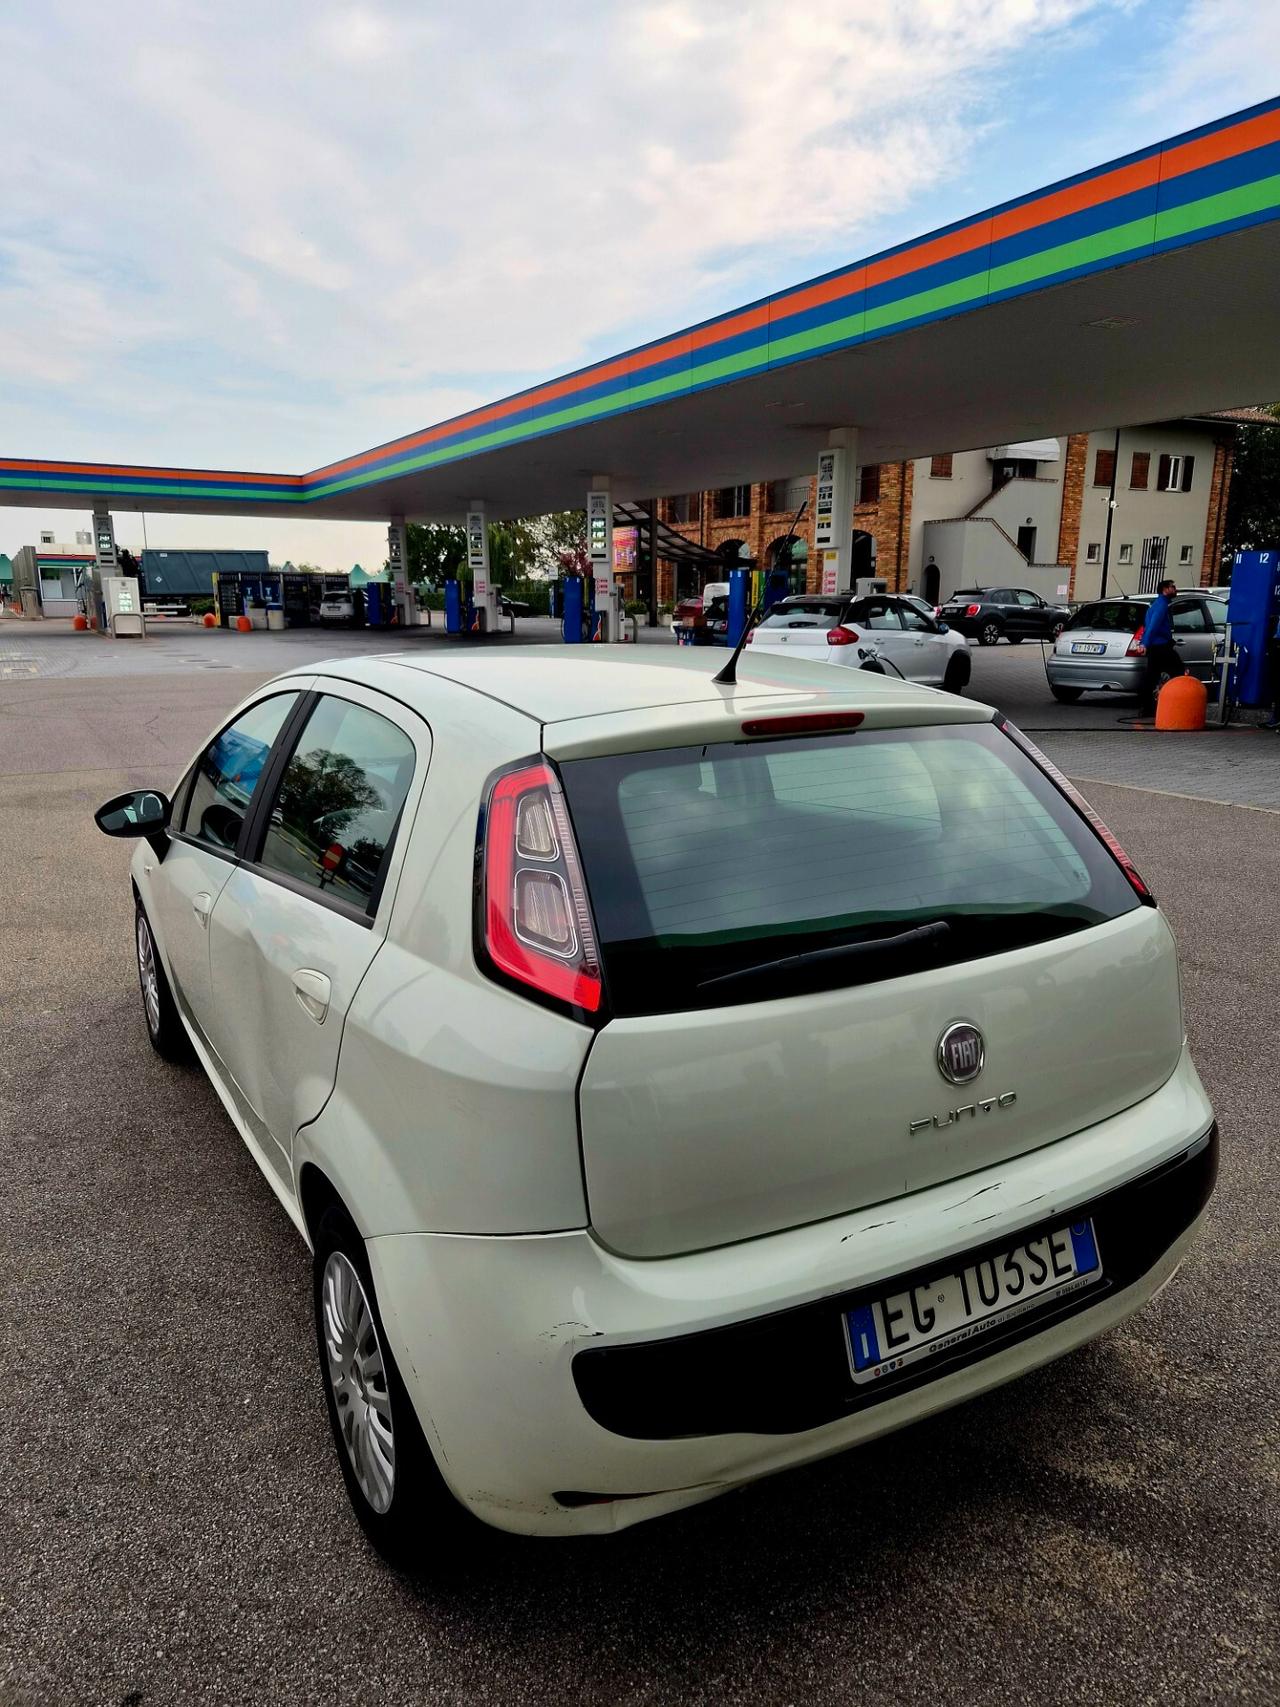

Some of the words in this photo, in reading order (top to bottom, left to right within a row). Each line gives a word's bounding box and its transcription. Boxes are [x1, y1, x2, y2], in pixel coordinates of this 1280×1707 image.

[1259, 552, 1269, 564] 12
[951, 1039, 976, 1070] FIAT
[910, 1091, 1016, 1136] PUNTO
[880, 1284, 936, 1349] EG
[957, 1232, 1072, 1317] 103SE
[929, 1329, 972, 1352] General
[972, 1318, 997, 1335] Auto
